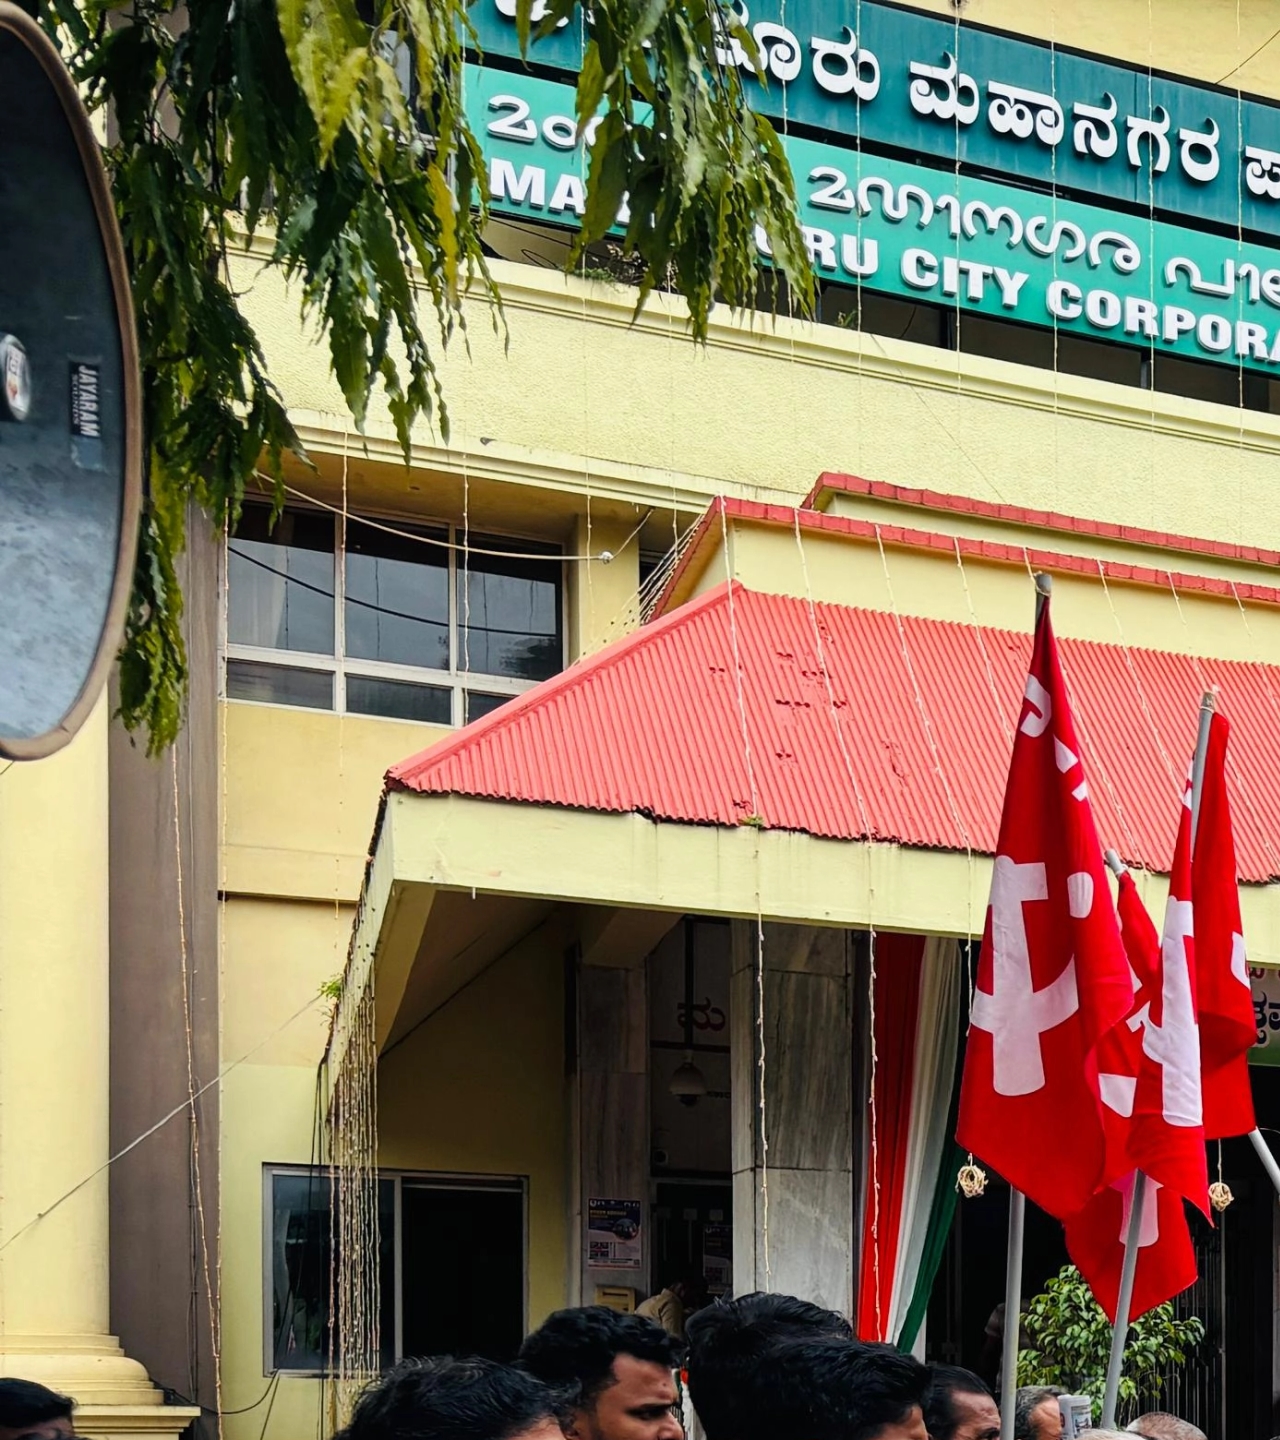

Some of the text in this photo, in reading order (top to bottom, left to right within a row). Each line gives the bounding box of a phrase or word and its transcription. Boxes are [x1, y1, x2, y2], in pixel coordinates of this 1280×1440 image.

[909, 51, 1221, 182] ಮಹಾನಗರ
[901, 248, 1030, 308] CITY
[78, 365, 100, 437] JAYARAM
